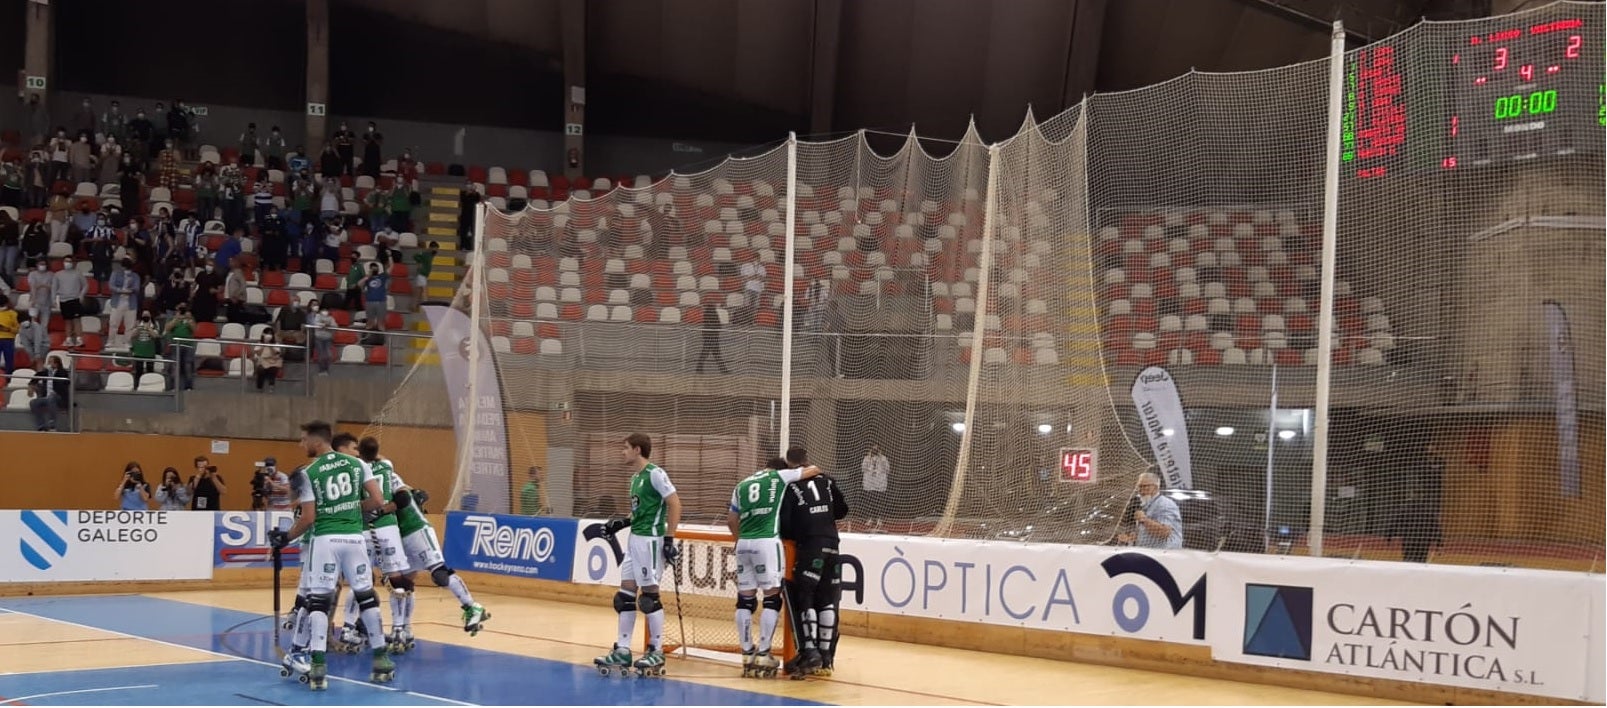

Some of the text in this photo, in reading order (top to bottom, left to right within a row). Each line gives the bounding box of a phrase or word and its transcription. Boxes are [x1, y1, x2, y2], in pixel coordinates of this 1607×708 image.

[1566, 35, 1581, 58] 2
[1493, 47, 1508, 70] 3
[27, 78, 45, 88] 10
[1519, 64, 1534, 82] 4
[309, 105, 325, 115] 11
[1494, 89, 1557, 119] 00:00
[567, 125, 582, 135] 12
[1064, 451, 1091, 478] 45
[326, 472, 352, 501] 68
[748, 482, 761, 503] 8
[807, 480, 820, 501] 1
[77, 510, 168, 525] DEPORTE
[77, 528, 159, 543] GALEGO
[463, 515, 555, 562] Reno
[641, 566, 648, 578] 9
[881, 545, 1081, 625] ÒPTICA
[1326, 602, 1521, 651] CARTÓN
[1325, 640, 1545, 685] ATLÁNTICA S.L.
